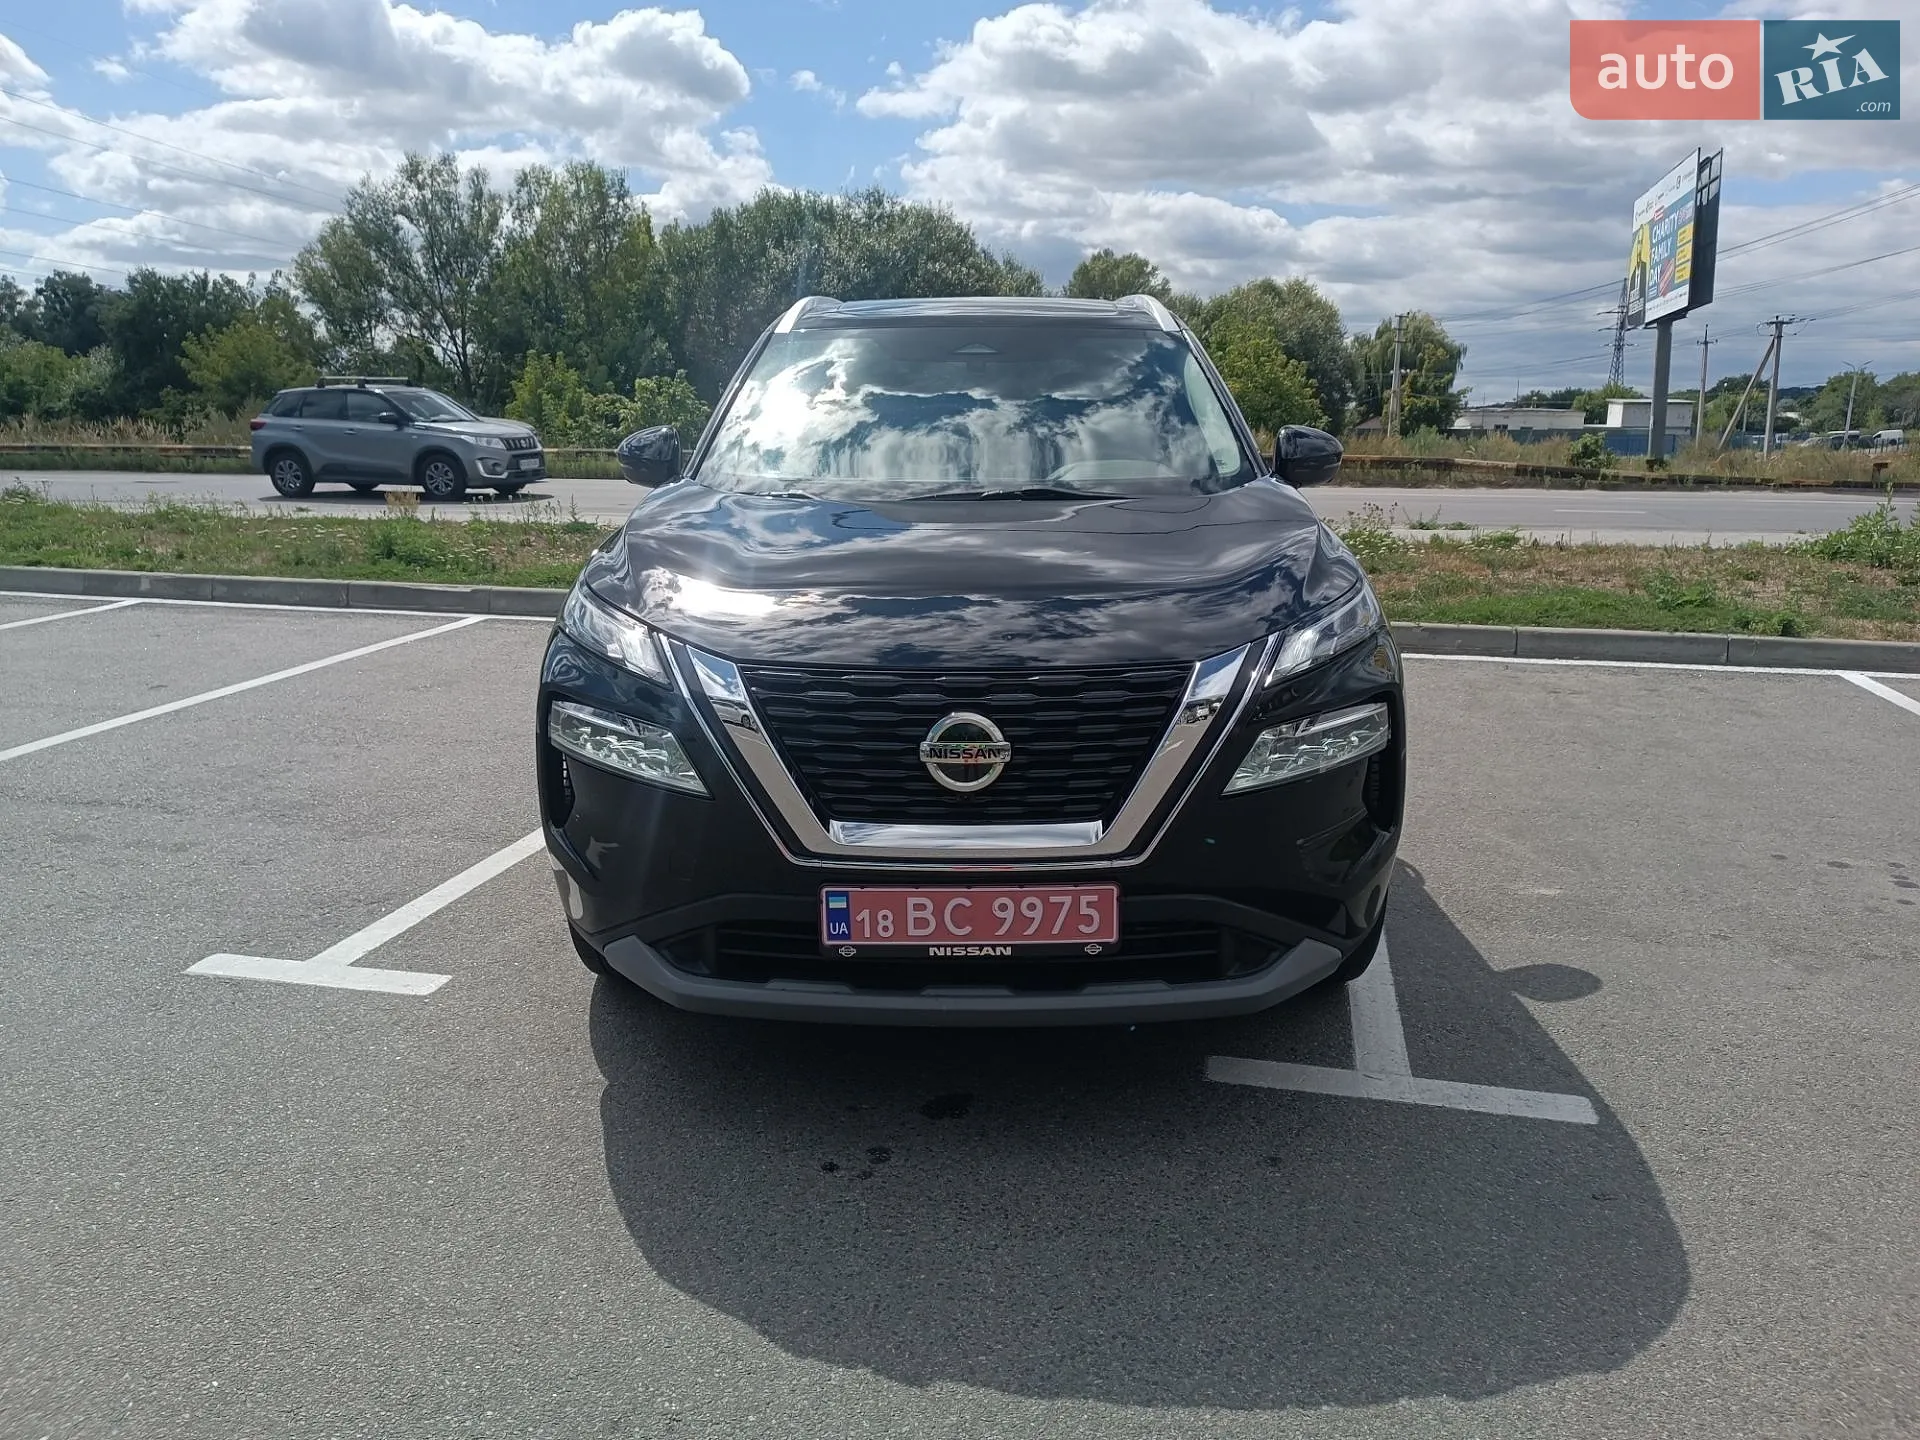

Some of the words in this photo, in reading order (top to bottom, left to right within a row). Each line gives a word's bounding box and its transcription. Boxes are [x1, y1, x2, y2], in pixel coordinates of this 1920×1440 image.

[1652, 210, 1679, 243] CHARITY
[1651, 237, 1672, 266] FAMILY
[1649, 264, 1662, 286] DAY
[927, 747, 1003, 759] NISSAN
[830, 923, 849, 935] UA
[855, 909, 894, 938] 18
[906, 896, 973, 937] BC
[992, 895, 1101, 936] 9975
[929, 946, 1012, 957] NISSAN
